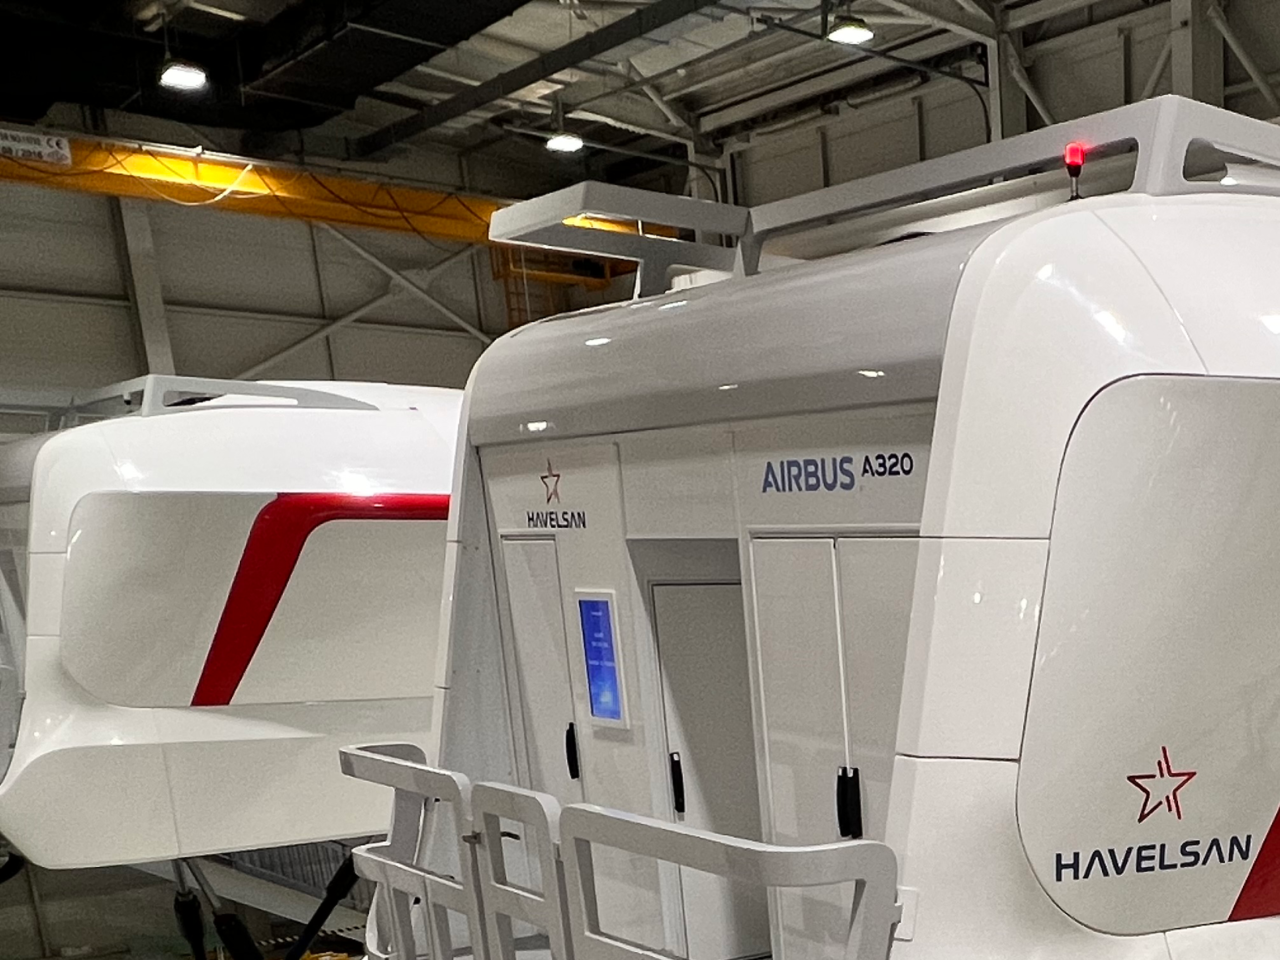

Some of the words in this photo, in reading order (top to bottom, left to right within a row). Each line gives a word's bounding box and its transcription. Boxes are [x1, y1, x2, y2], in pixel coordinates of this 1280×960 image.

[762, 456, 855, 493] AIRBUS
[861, 452, 914, 477] A320
[526, 511, 586, 529] HAVELSAN
[1055, 834, 1252, 882] HAVELSAN
